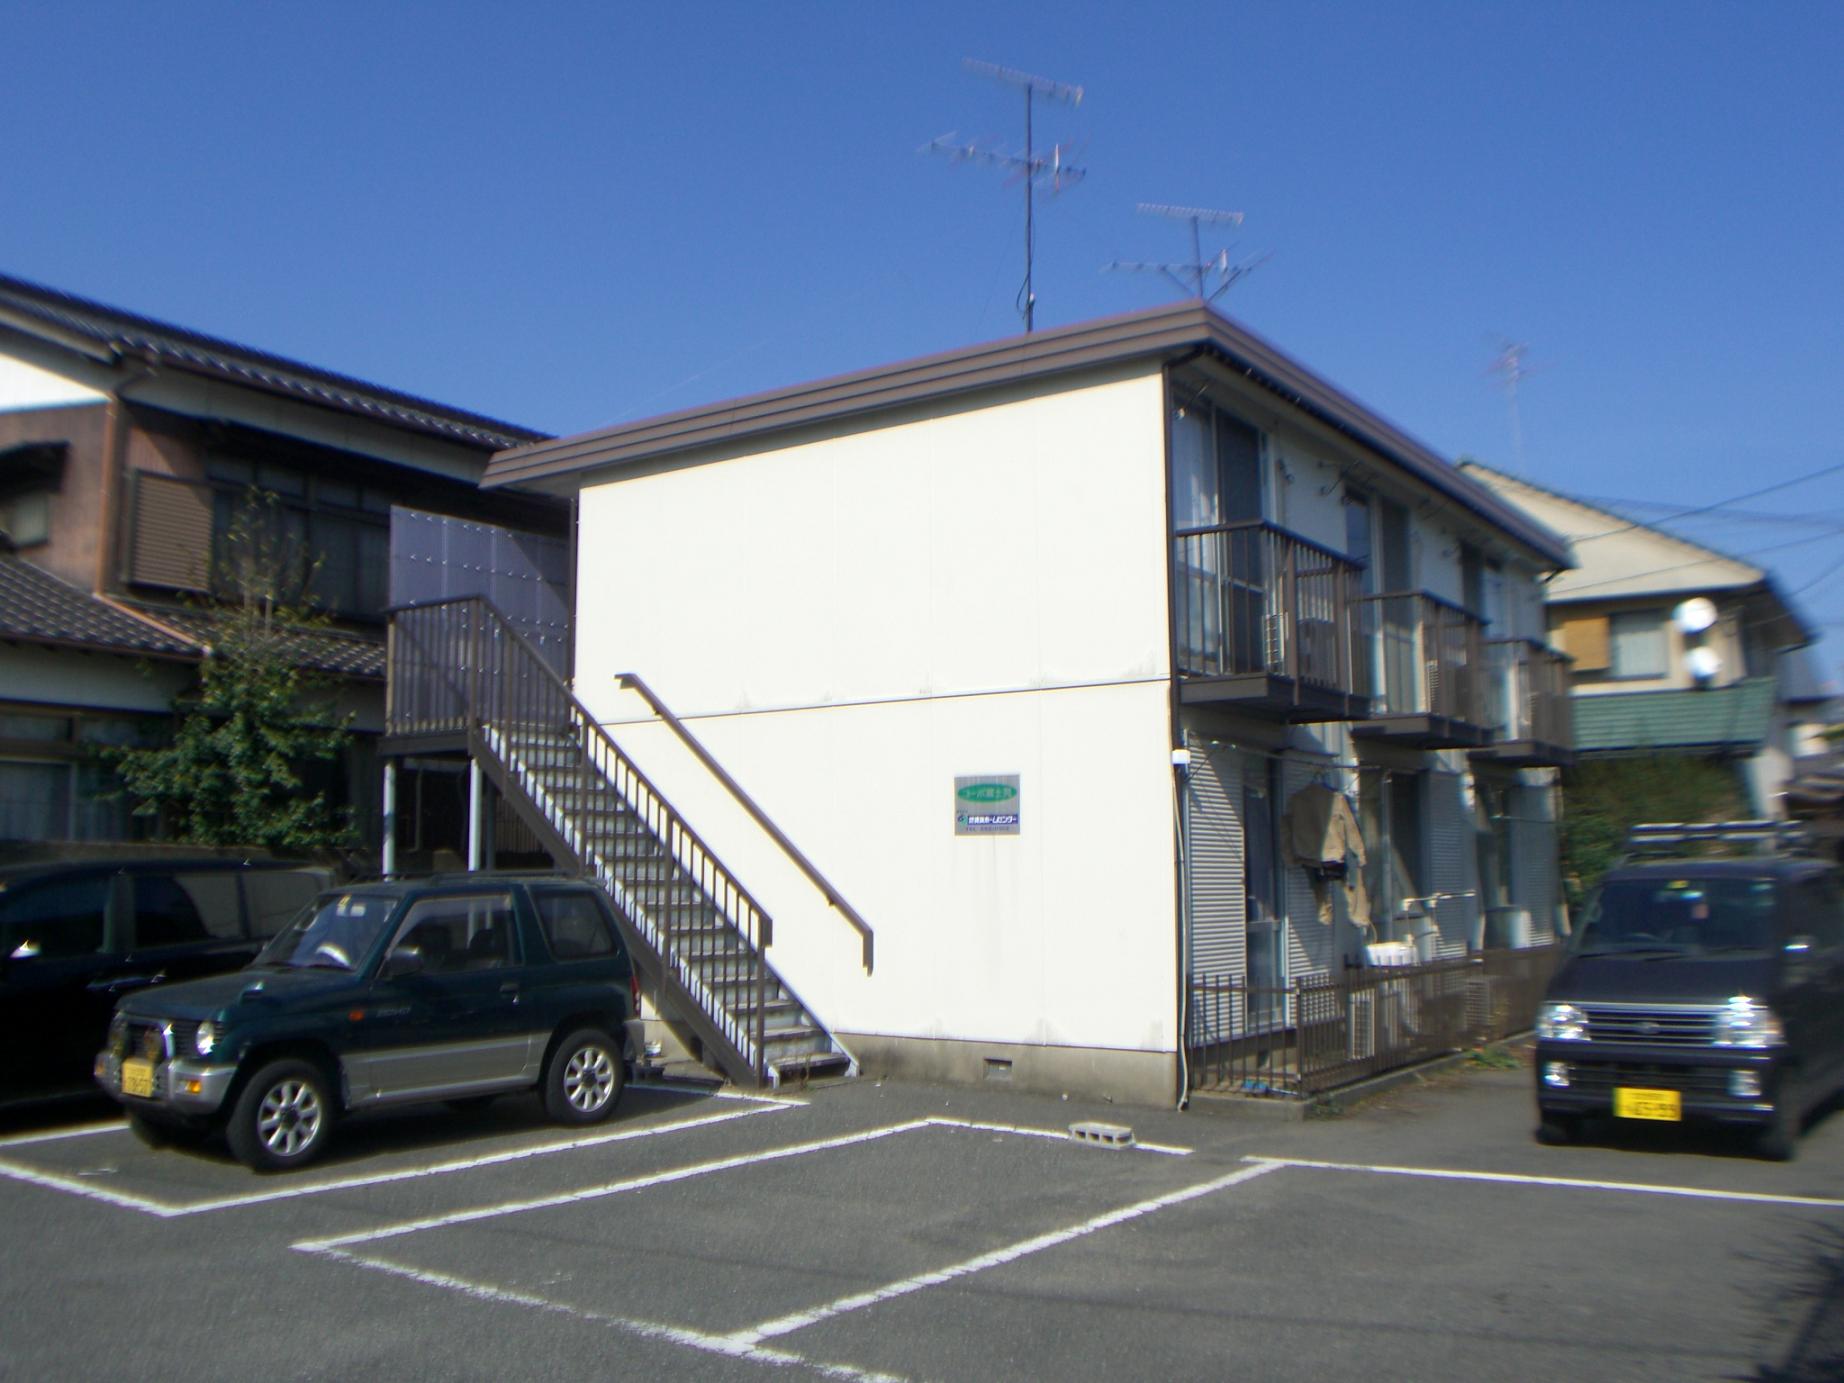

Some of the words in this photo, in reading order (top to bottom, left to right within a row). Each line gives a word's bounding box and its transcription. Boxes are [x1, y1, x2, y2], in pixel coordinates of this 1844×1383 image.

[968, 815, 1017, 824] ホームセンター
